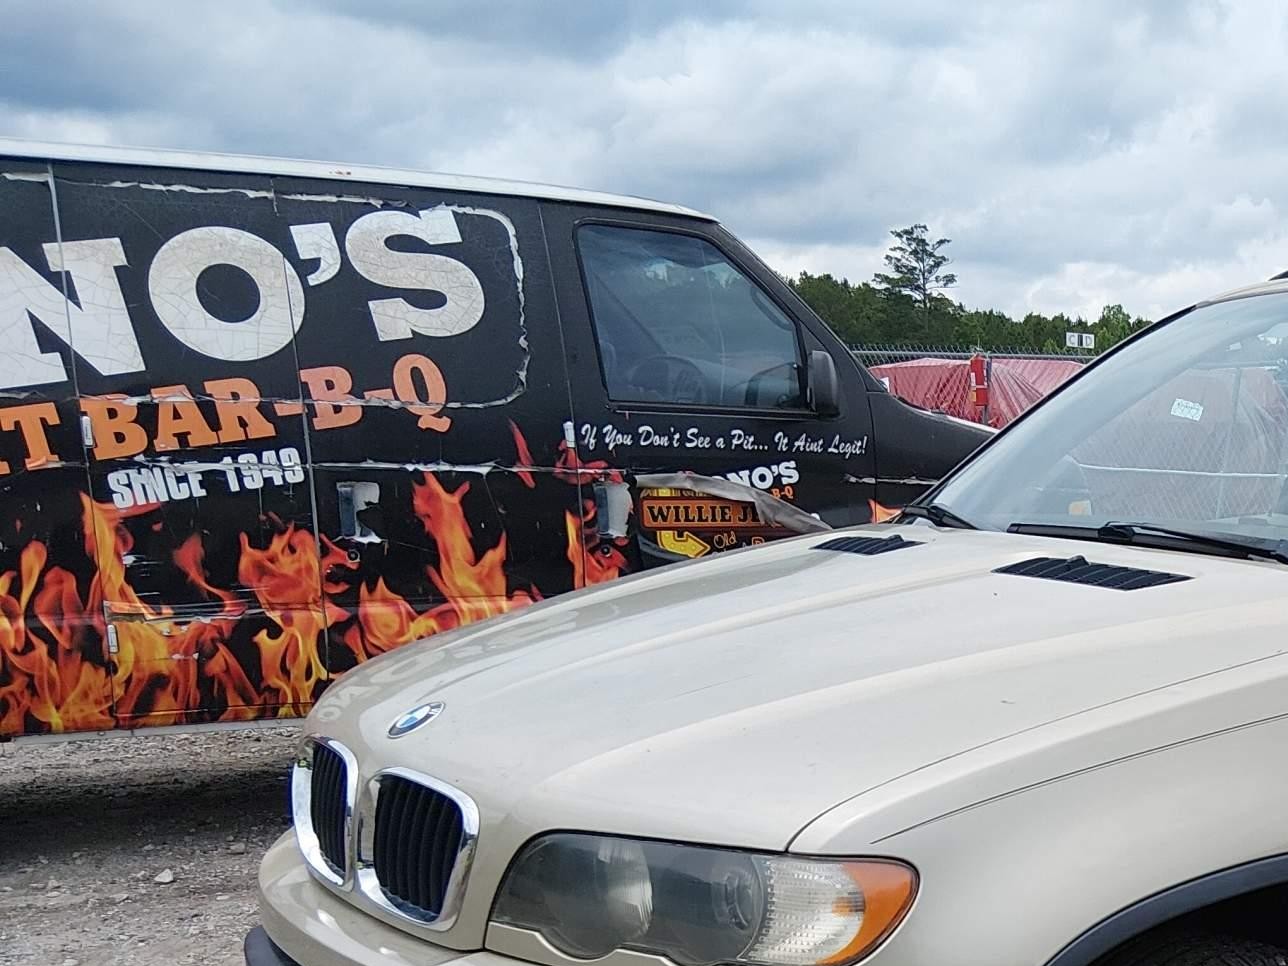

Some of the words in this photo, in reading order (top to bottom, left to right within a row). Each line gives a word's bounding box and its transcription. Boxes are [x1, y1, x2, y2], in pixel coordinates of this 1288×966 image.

[80, 353, 452, 461] BAR-B-Q
[581, 423, 598, 450] If
[602, 424, 633, 451] You
[638, 425, 681, 448] Don't
[685, 427, 712, 448] See
[715, 437, 726, 449] a
[731, 429, 768, 450] Pit...
[774, 431, 789, 452] It
[792, 432, 824, 453] Aint
[828, 434, 868, 459] Legit!
[219, 447, 305, 492] 1949
[646, 504, 731, 523] WILLIE
[713, 531, 737, 549] Old
